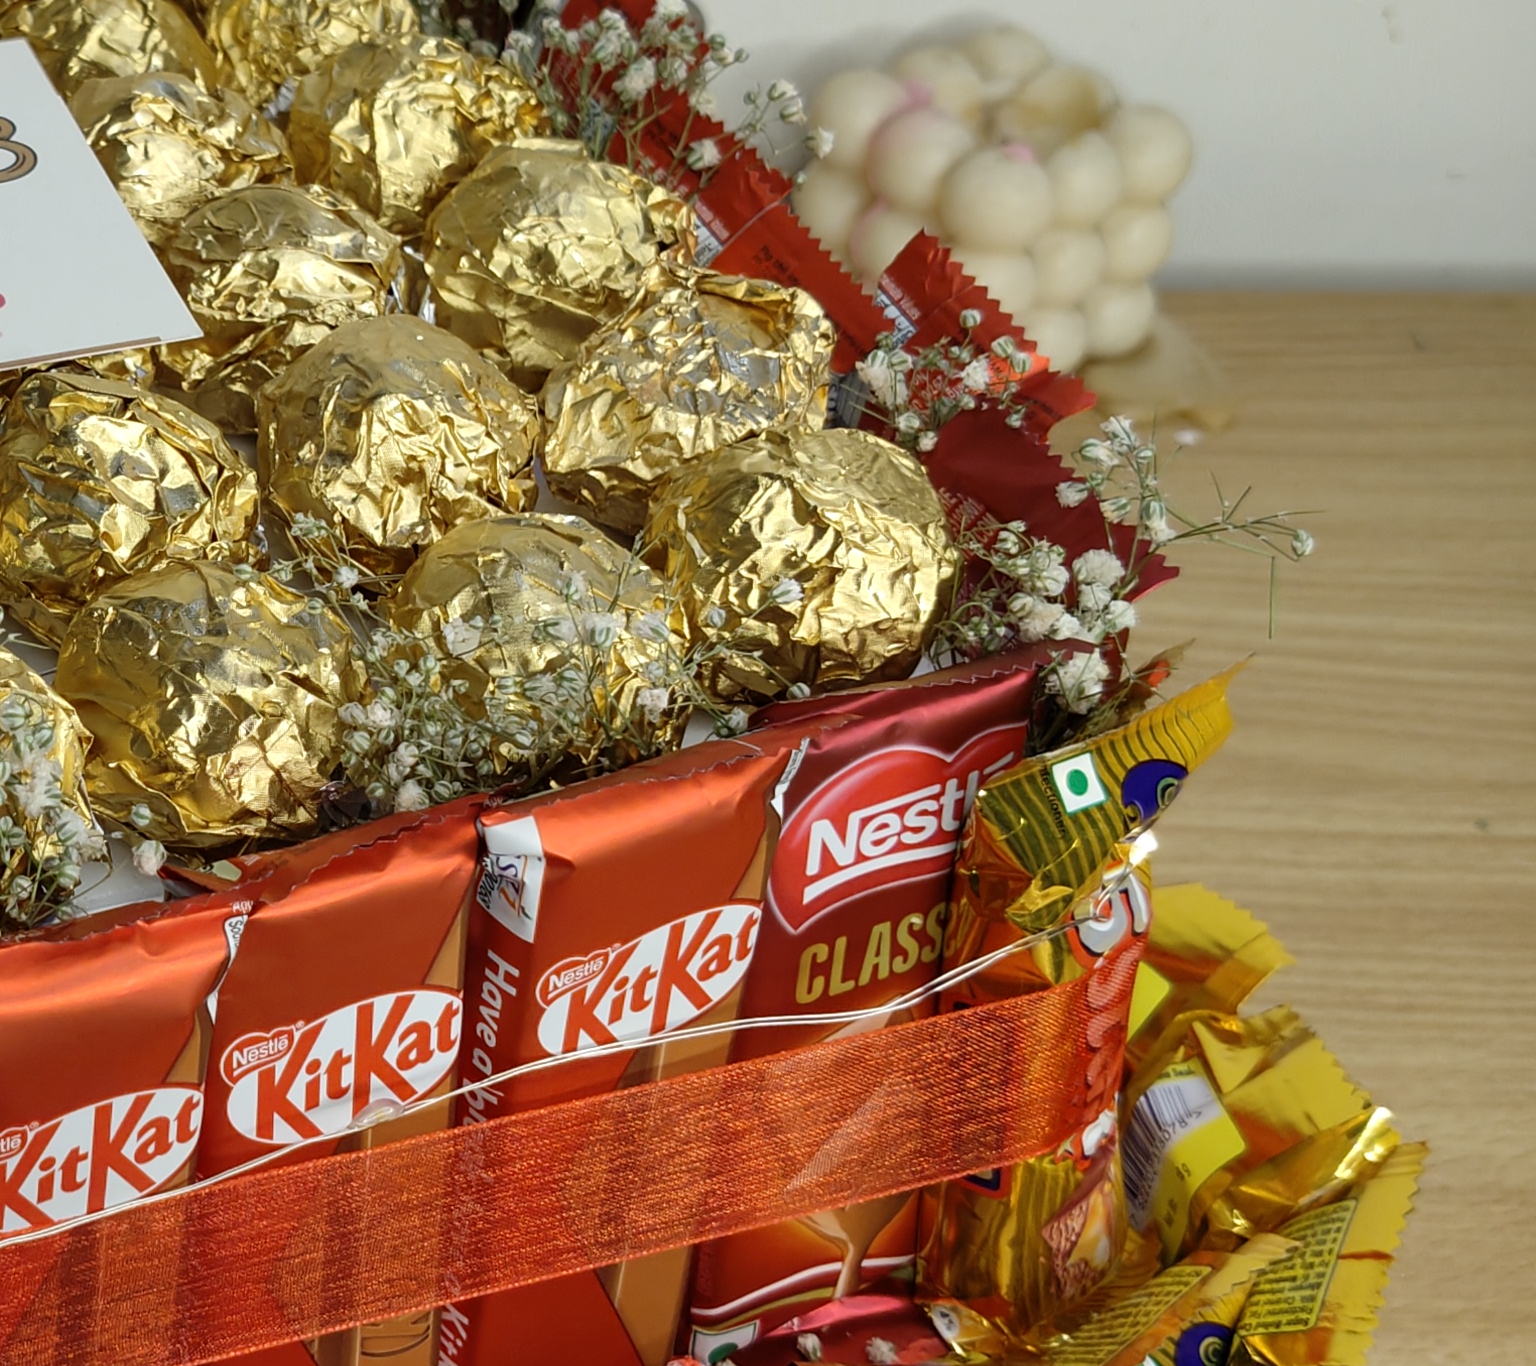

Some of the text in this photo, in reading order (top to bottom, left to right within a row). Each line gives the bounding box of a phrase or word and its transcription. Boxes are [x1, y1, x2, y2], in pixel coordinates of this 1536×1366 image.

[804, 749, 1015, 878] Nestl
[474, 948, 520, 1048] Have
[547, 956, 604, 998] Nestlé
[560, 909, 761, 1056] KitKat
[795, 901, 948, 1006] CLASS
[231, 1033, 290, 1077] Nestlé
[254, 993, 461, 1142] KitKat
[471, 1047, 493, 1076] a
